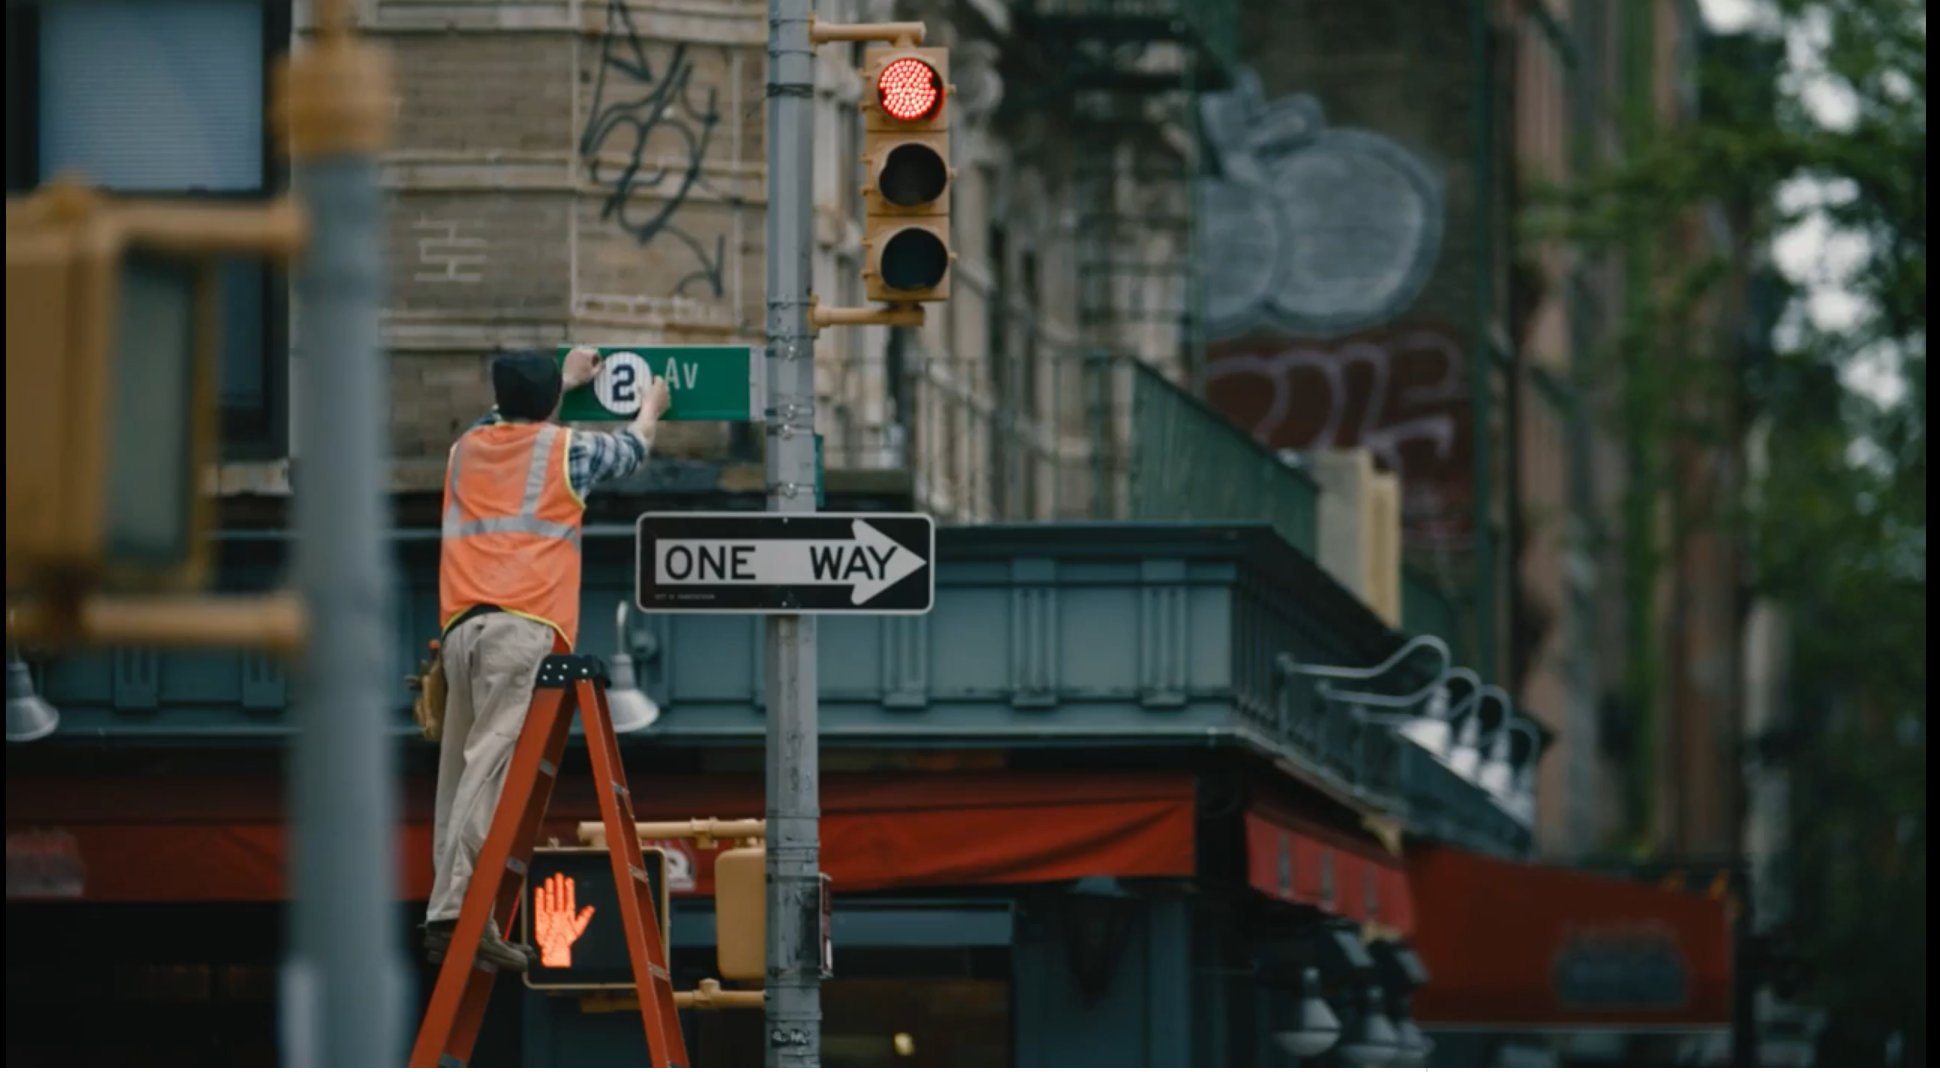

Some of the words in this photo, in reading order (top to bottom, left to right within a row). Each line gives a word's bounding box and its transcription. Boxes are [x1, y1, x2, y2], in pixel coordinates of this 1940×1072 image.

[612, 364, 635, 402] 2
[665, 357, 698, 390] Av
[665, 545, 756, 580] ONE
[810, 545, 898, 580] WAY
